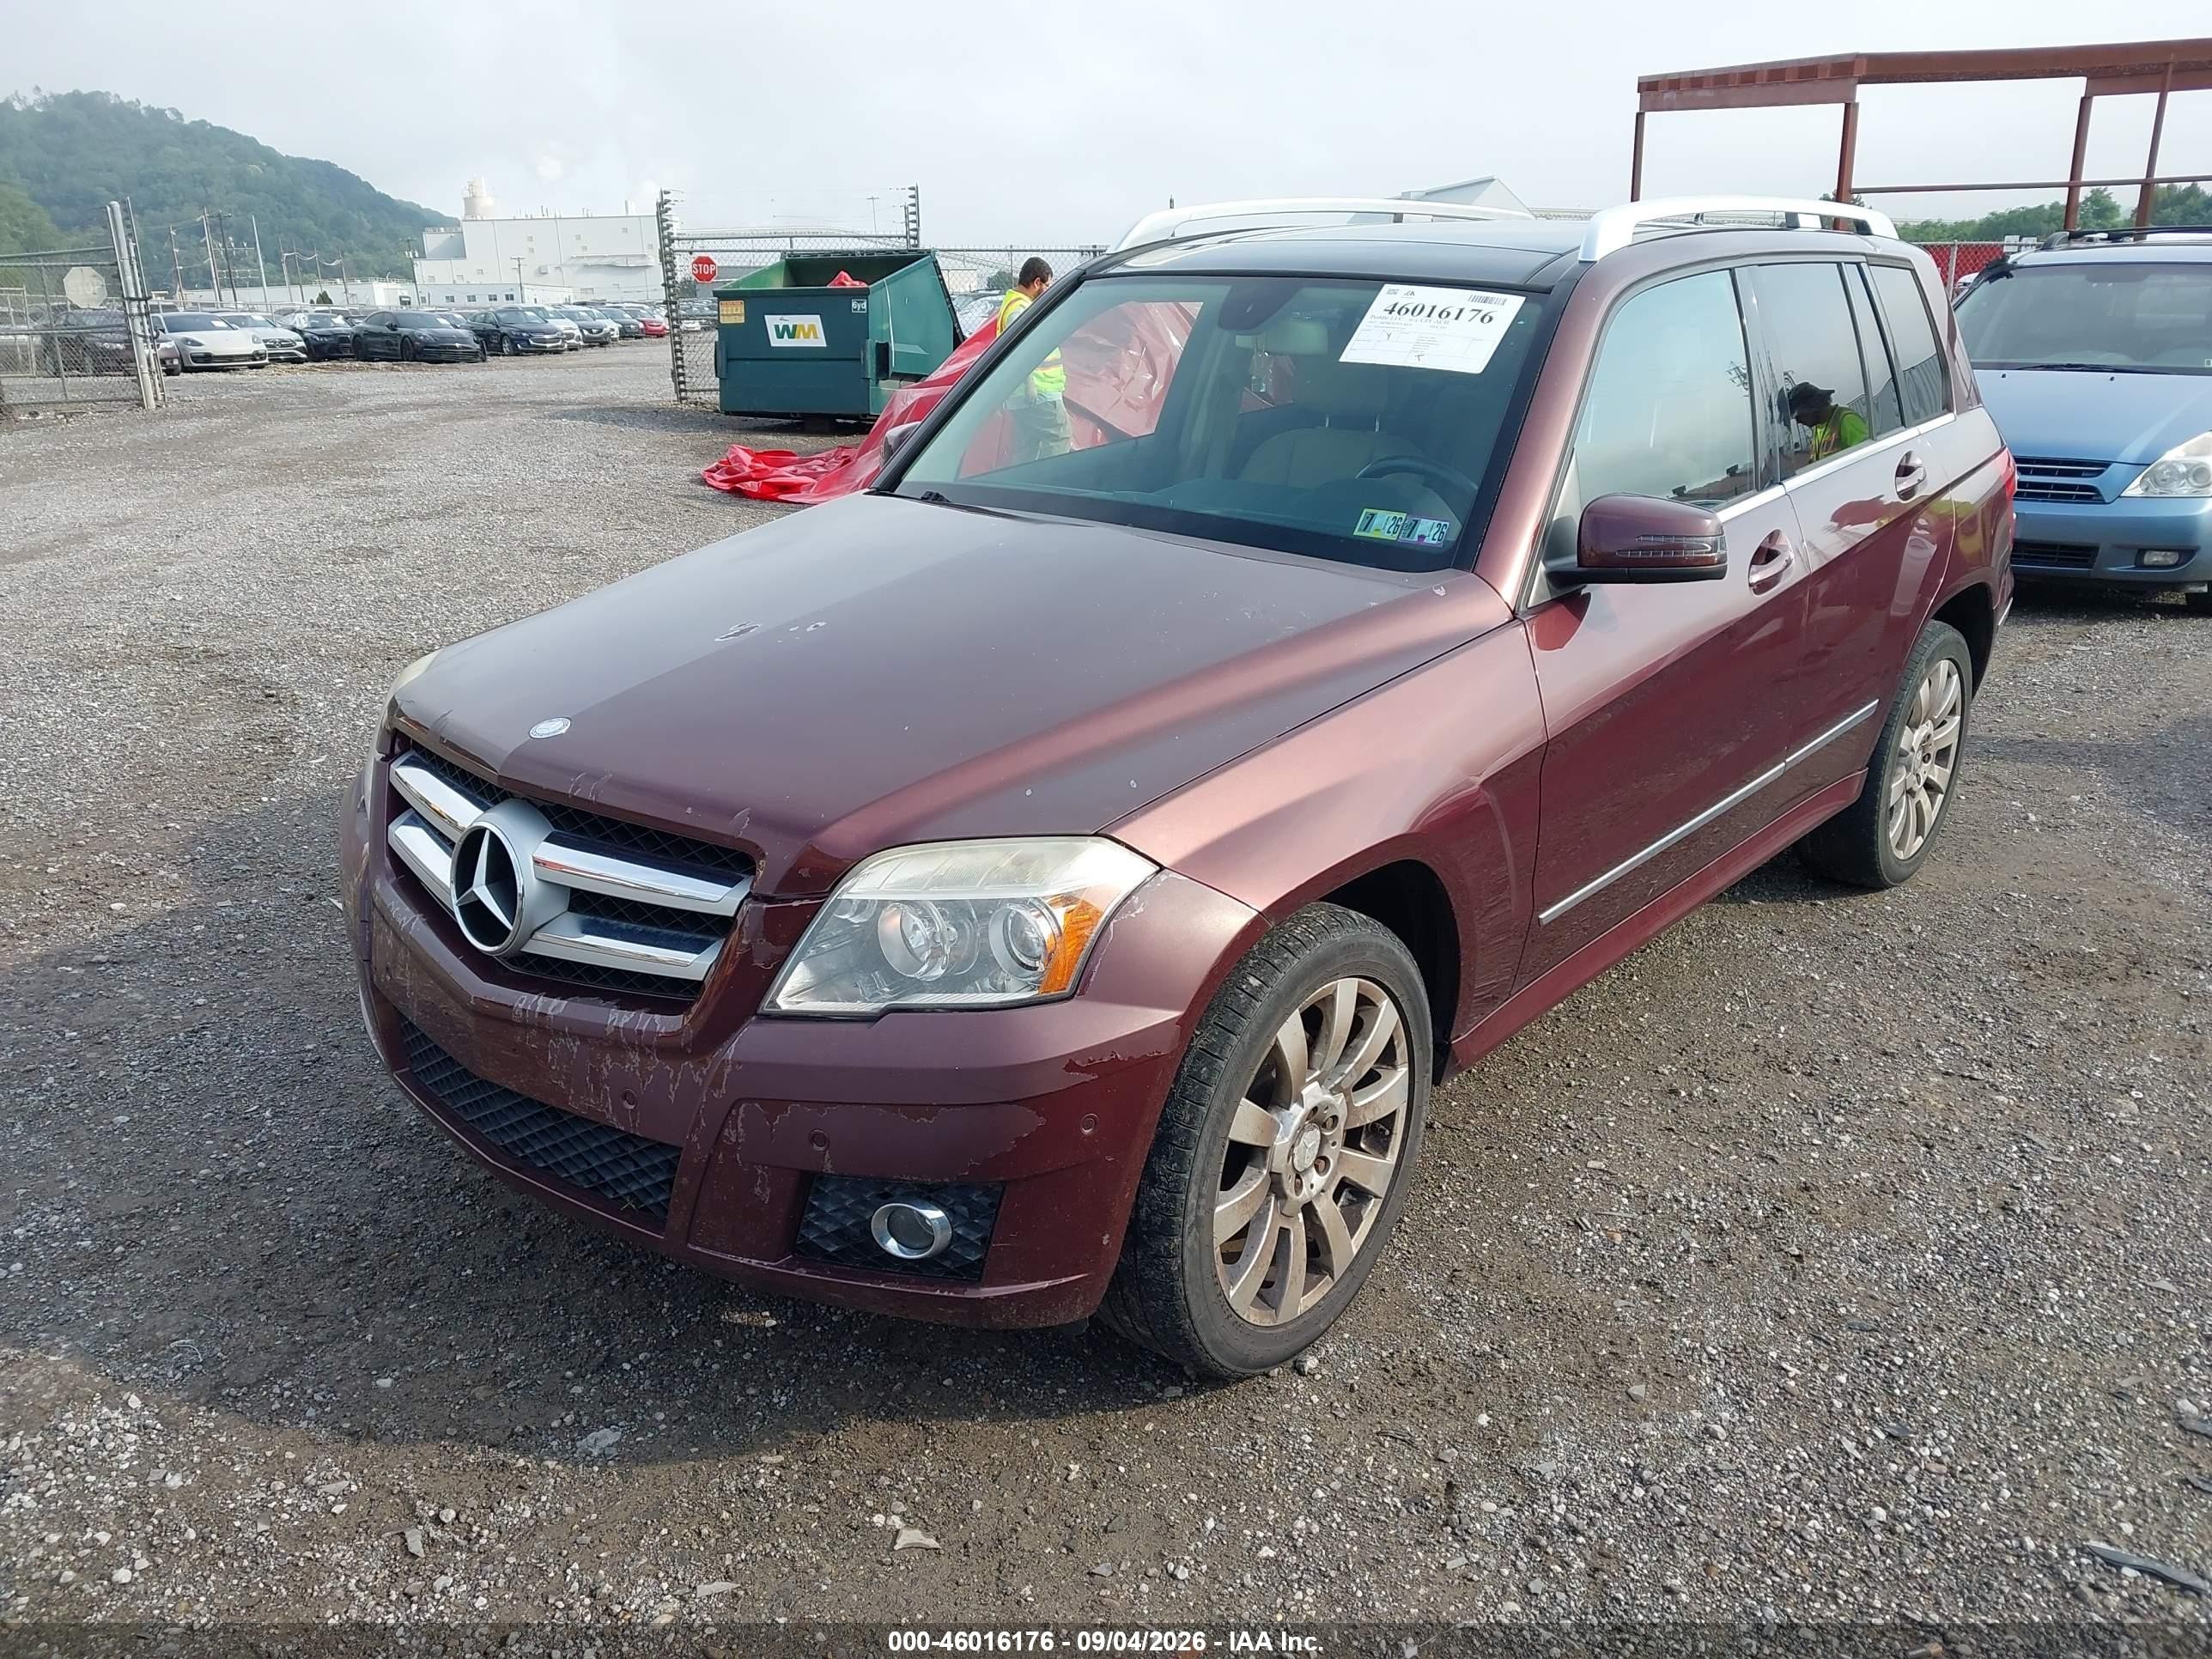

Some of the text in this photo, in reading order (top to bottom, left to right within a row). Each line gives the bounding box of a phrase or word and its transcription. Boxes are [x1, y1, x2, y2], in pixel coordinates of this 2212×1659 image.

[692, 263, 716, 275] STOP
[1383, 301, 1498, 325] 46016176
[774, 324, 820, 339] WM
[1363, 513, 1402, 535] 7 26
[1407, 520, 1448, 542] 7 26
